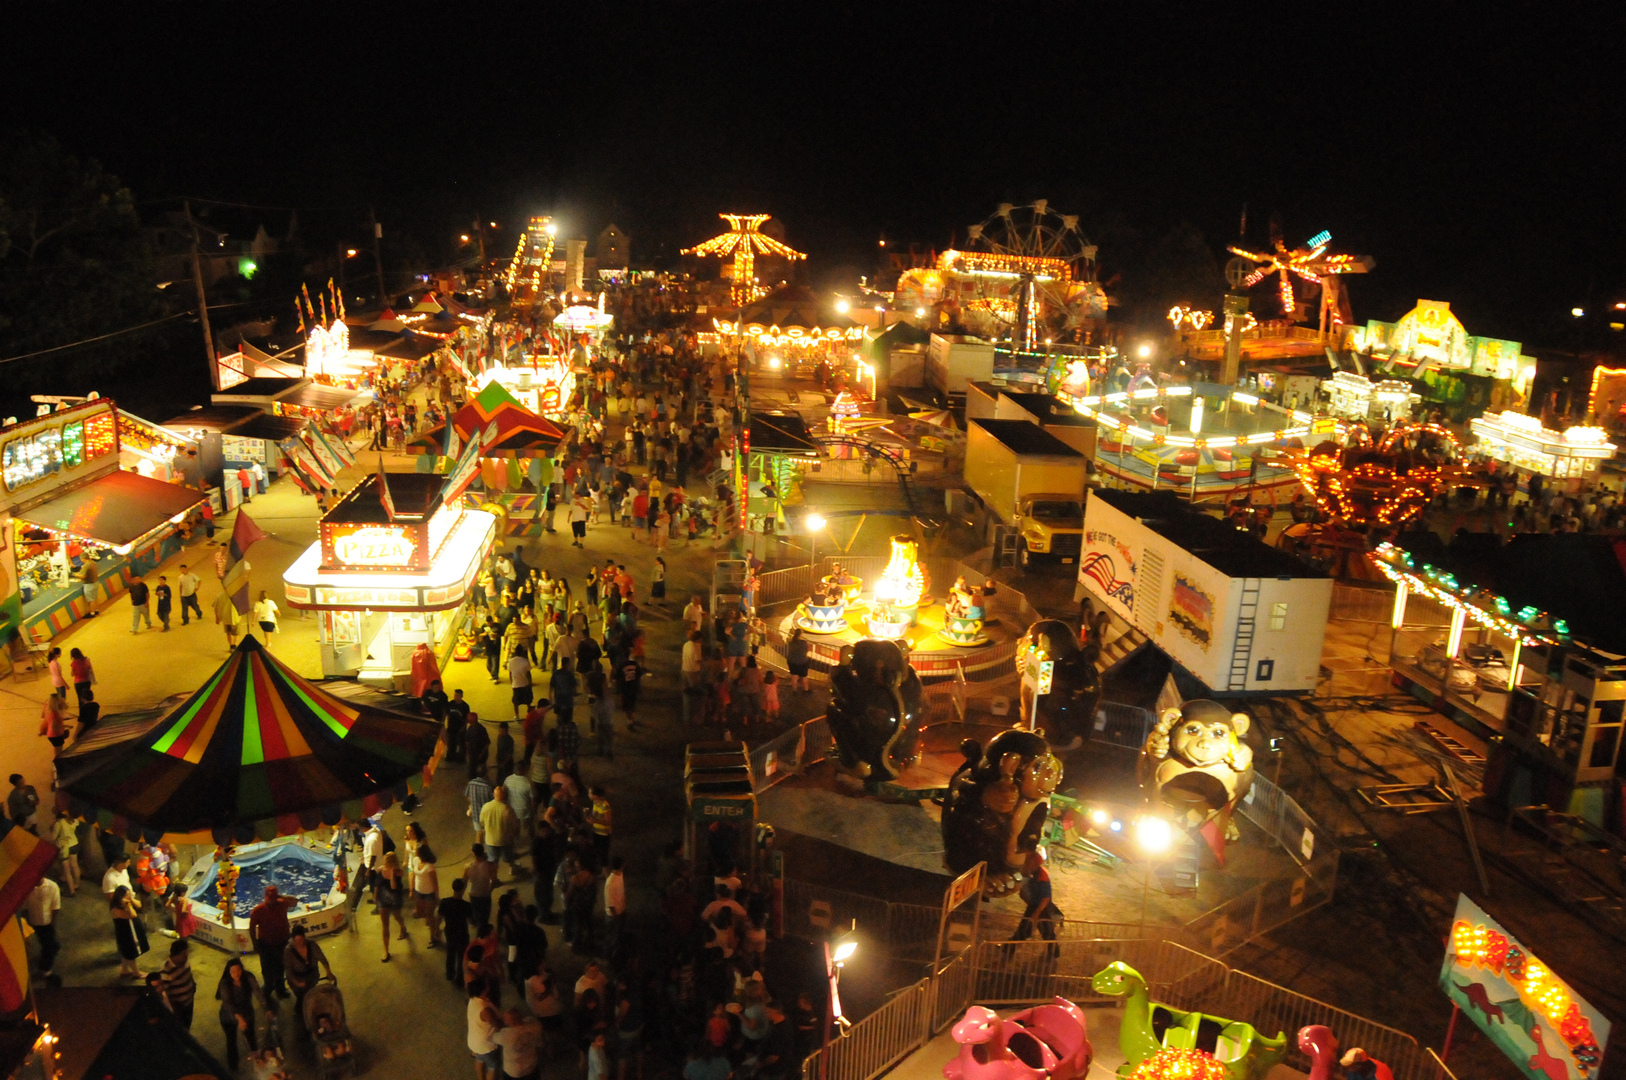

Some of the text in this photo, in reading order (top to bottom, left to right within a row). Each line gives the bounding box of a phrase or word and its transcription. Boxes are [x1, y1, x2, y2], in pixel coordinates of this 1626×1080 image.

[343, 541, 404, 559] PIZZA
[321, 588, 374, 604] PIZZA
[704, 805, 744, 816] ENTER
